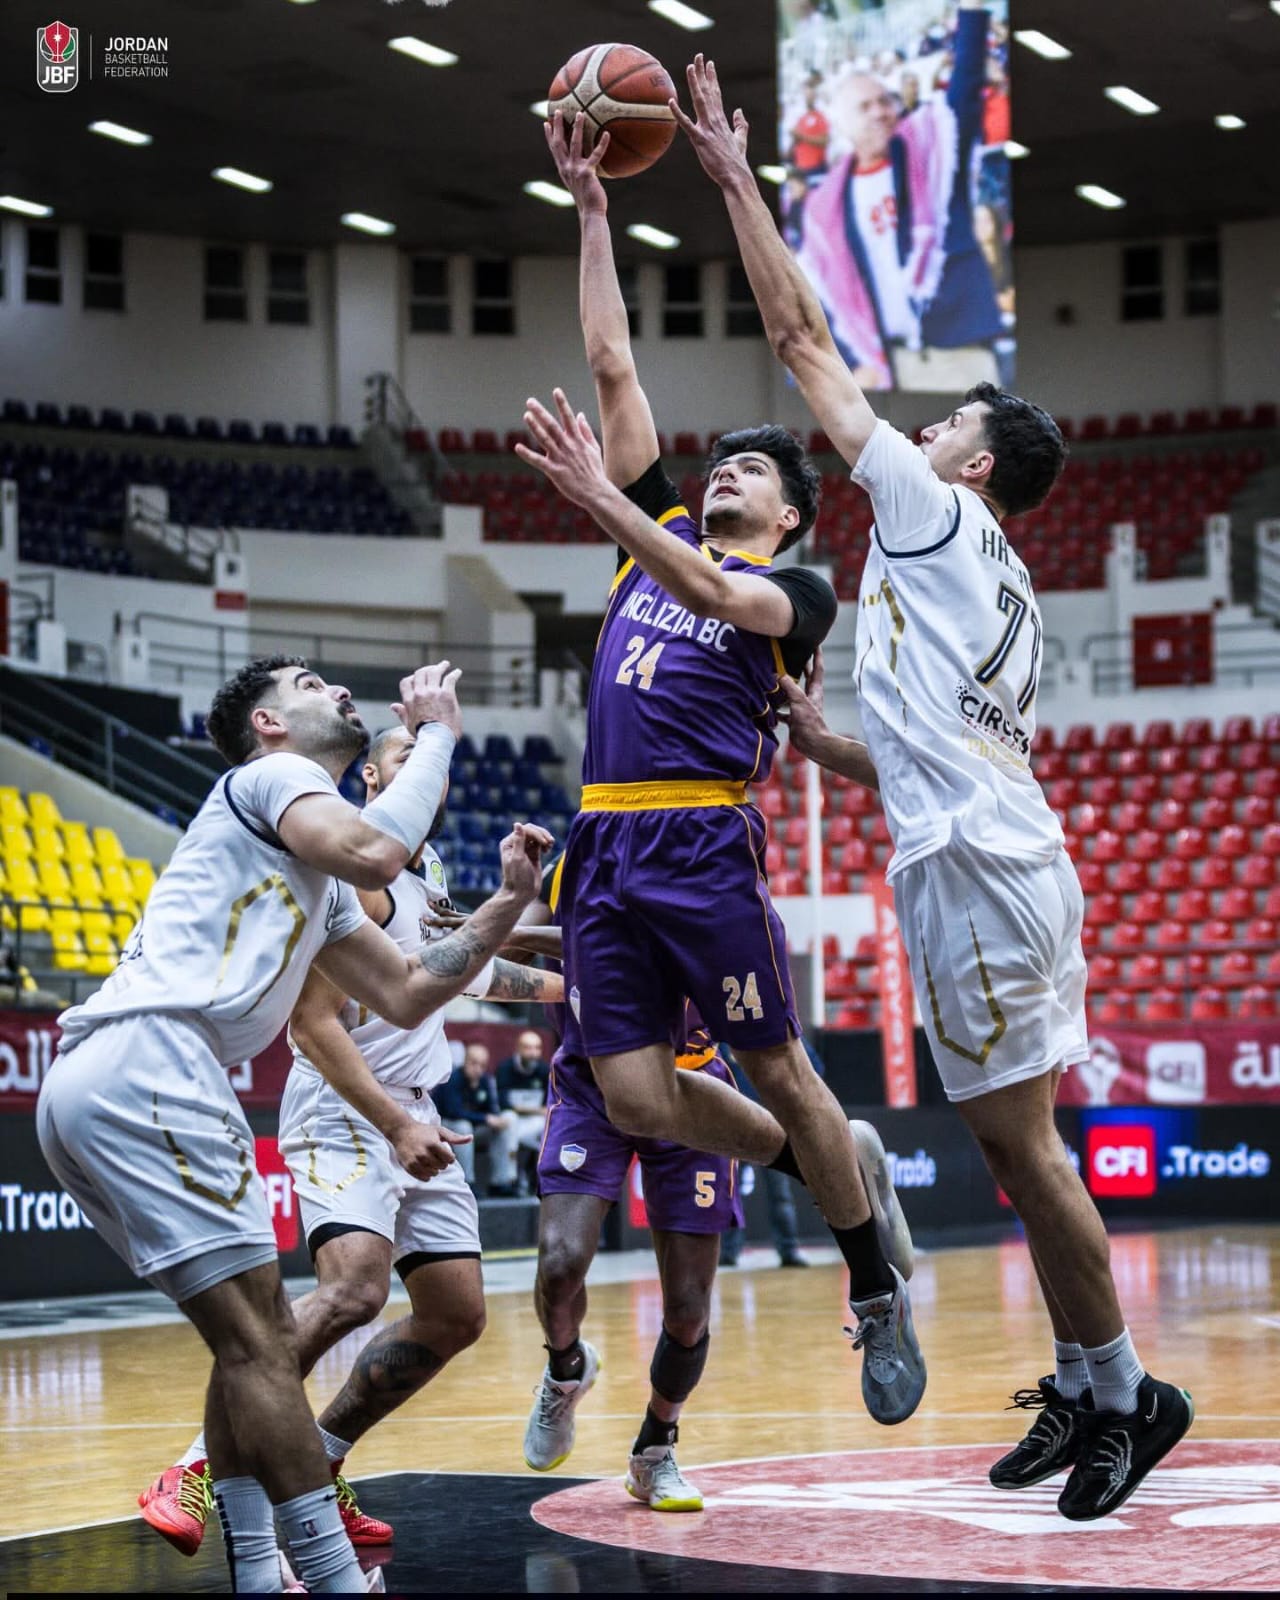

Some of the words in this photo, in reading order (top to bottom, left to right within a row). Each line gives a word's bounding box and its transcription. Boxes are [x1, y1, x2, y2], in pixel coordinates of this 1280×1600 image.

[696, 617, 737, 652] BC
[615, 635, 666, 691] 24
[722, 971, 764, 1021] 24
[1094, 1146, 1148, 1177] CFI
[262, 1173, 291, 1217] FI
[694, 1171, 716, 1208] 5
